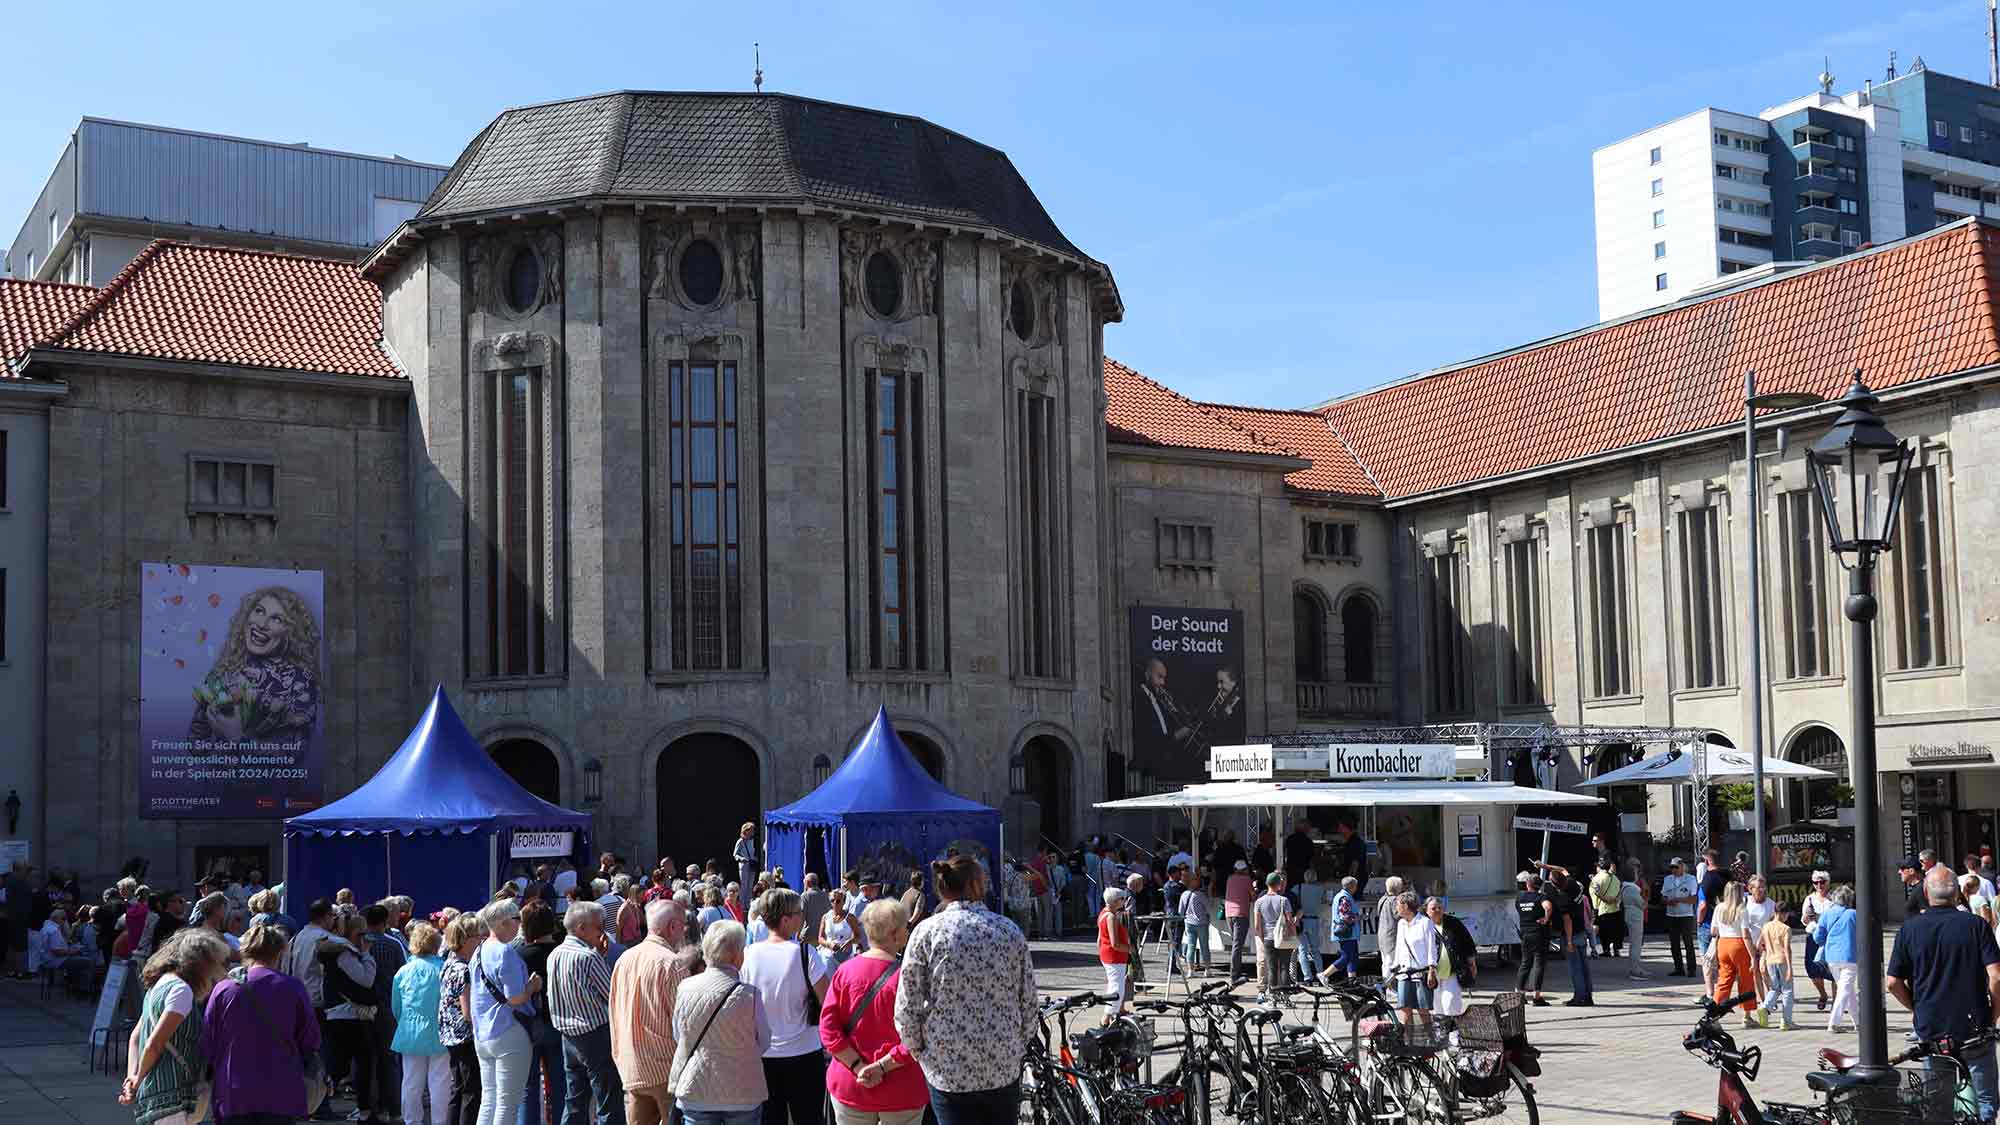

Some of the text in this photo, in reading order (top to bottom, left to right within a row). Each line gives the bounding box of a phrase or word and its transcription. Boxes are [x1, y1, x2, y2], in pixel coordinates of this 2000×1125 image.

[1151, 615, 1229, 633] Der Sound
[1151, 636, 1224, 653] der Stadt
[151, 740, 193, 750] Freuen
[194, 740, 212, 750] Sie
[214, 740, 237, 750] sich
[239, 740, 257, 750] mit
[281, 740, 301, 751] auf
[152, 754, 295, 766] unvergessliche Momente
[1215, 752, 1269, 773] Krombacher
[1336, 748, 1423, 773] Krombacher
[152, 768, 308, 781] in der Spielzeit 2024/2025!
[511, 834, 561, 848] NFORMATION
